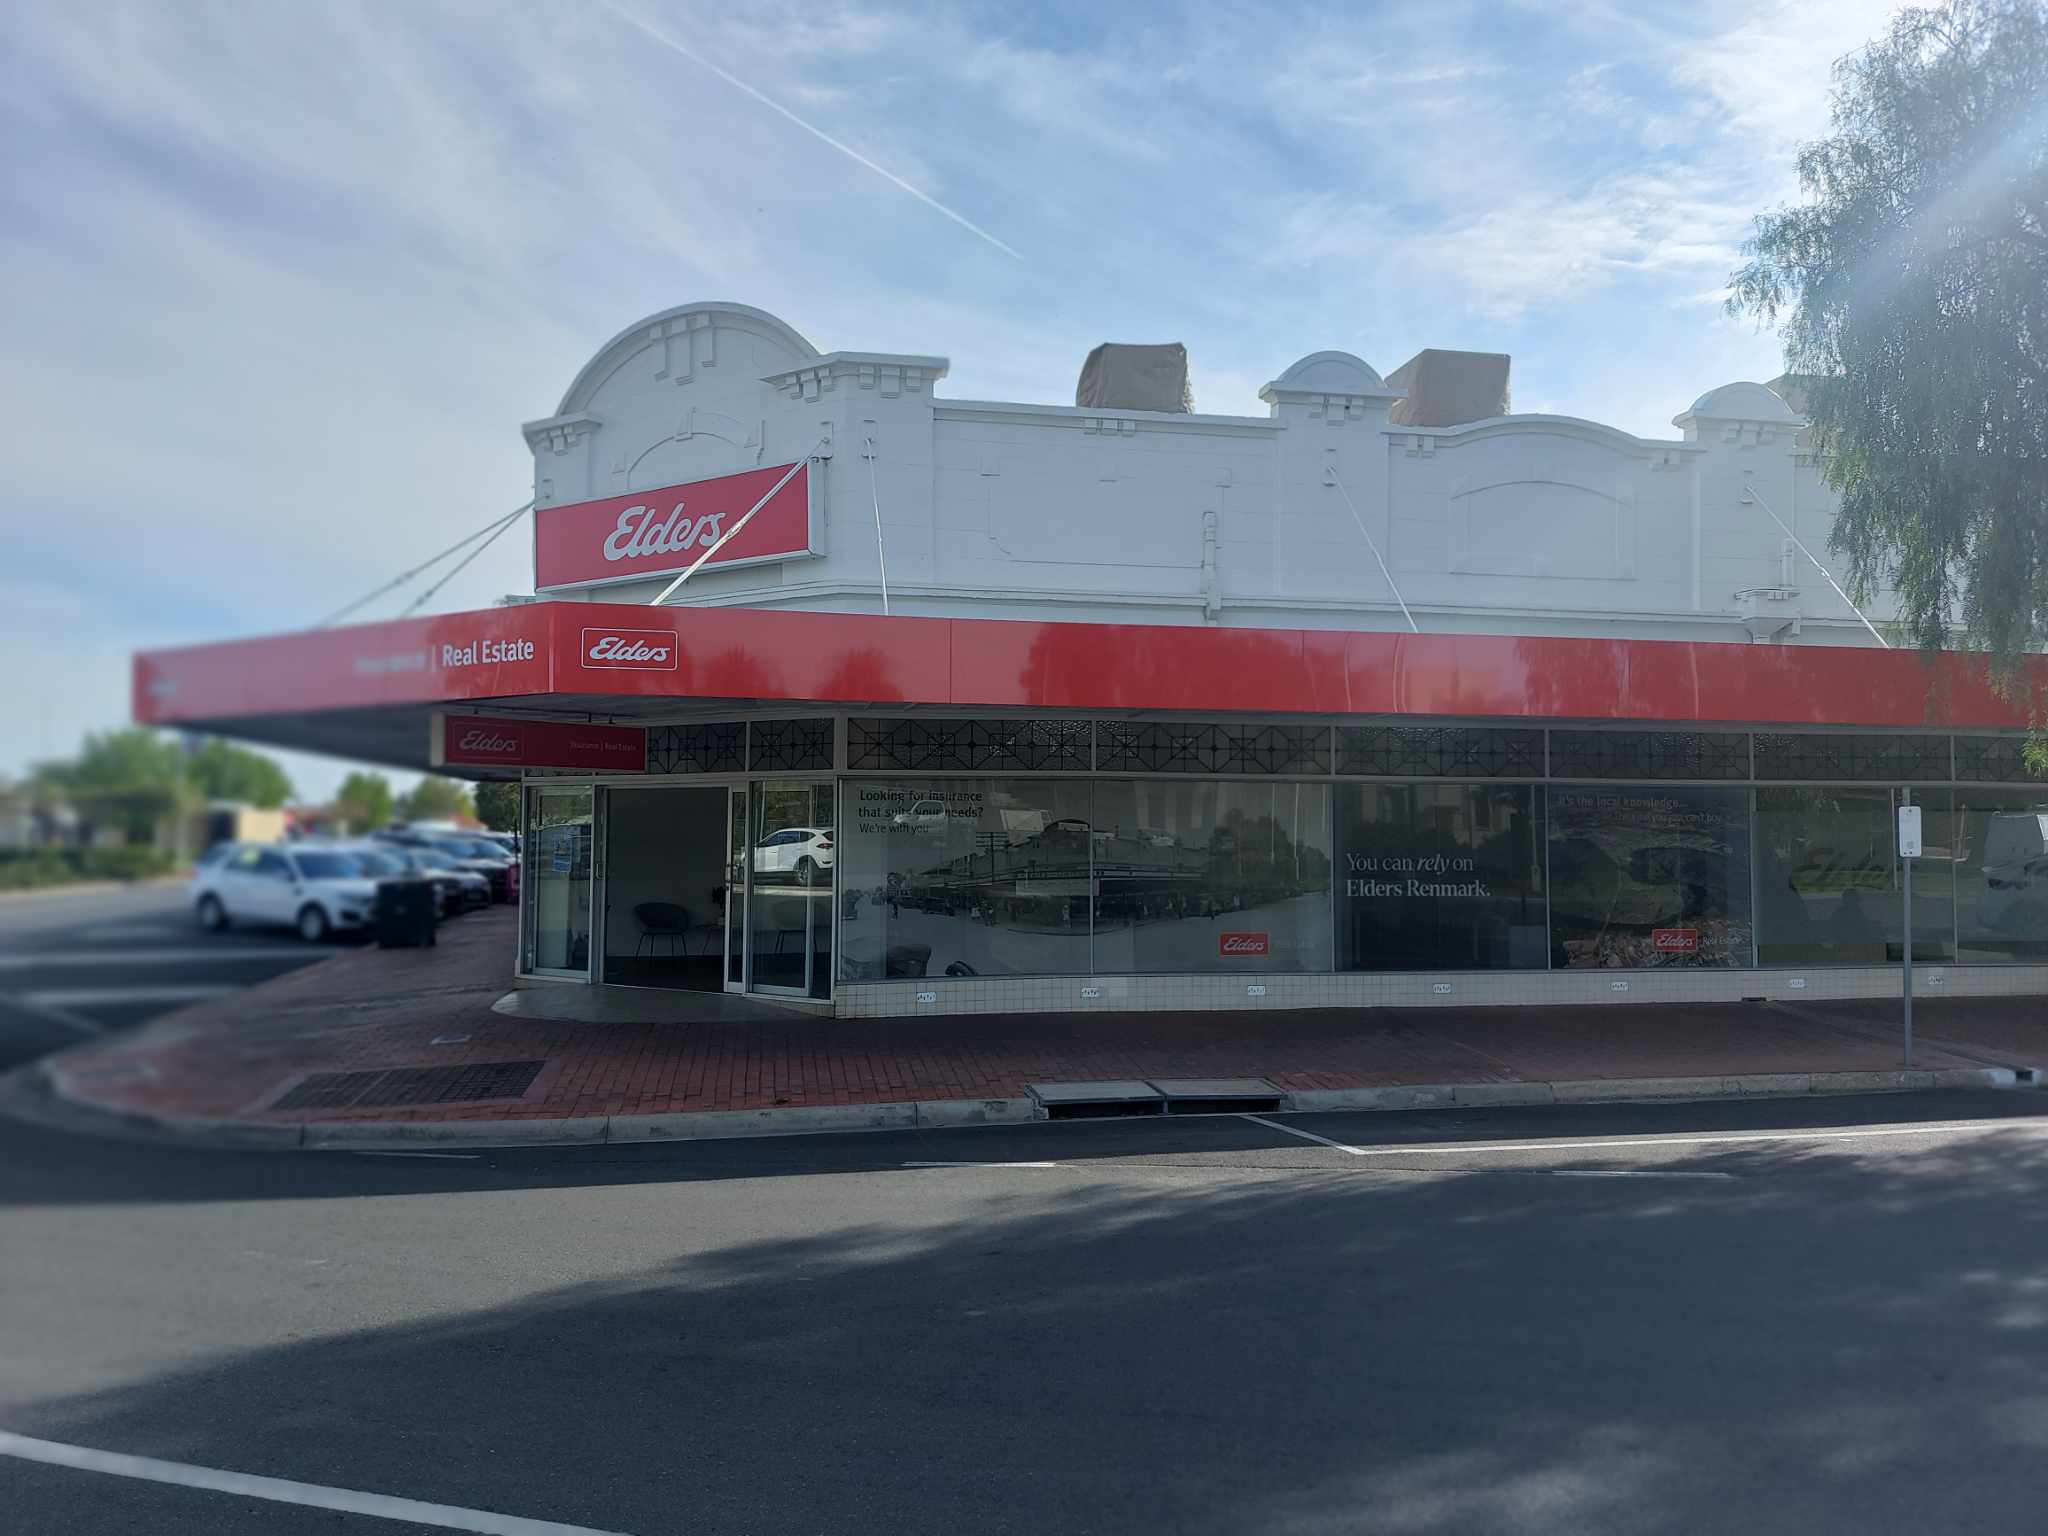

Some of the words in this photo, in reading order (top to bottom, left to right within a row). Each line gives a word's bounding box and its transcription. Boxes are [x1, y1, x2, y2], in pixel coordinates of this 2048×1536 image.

[604, 502, 728, 561] Elders
[443, 640, 478, 667] Real
[482, 638, 534, 663] Estate
[589, 636, 671, 662] Elders
[459, 730, 519, 752] Elders
[860, 789, 905, 806] Looking
[909, 789, 925, 801] for
[929, 789, 983, 801] insurance
[859, 806, 881, 818] that
[885, 806, 911, 818] suits
[944, 805, 984, 818] needs?
[859, 822, 886, 833] We're
[888, 822, 909, 833] with
[1346, 852, 1378, 871] You
[1382, 857, 1413, 871] can
[1416, 853, 1450, 876] rely
[1453, 857, 1474, 871] on
[1346, 879, 1403, 897] Elders
[1407, 879, 1491, 897] Renmark.
[1223, 936, 1265, 951] Elders
[1656, 933, 1696, 947] Elders
